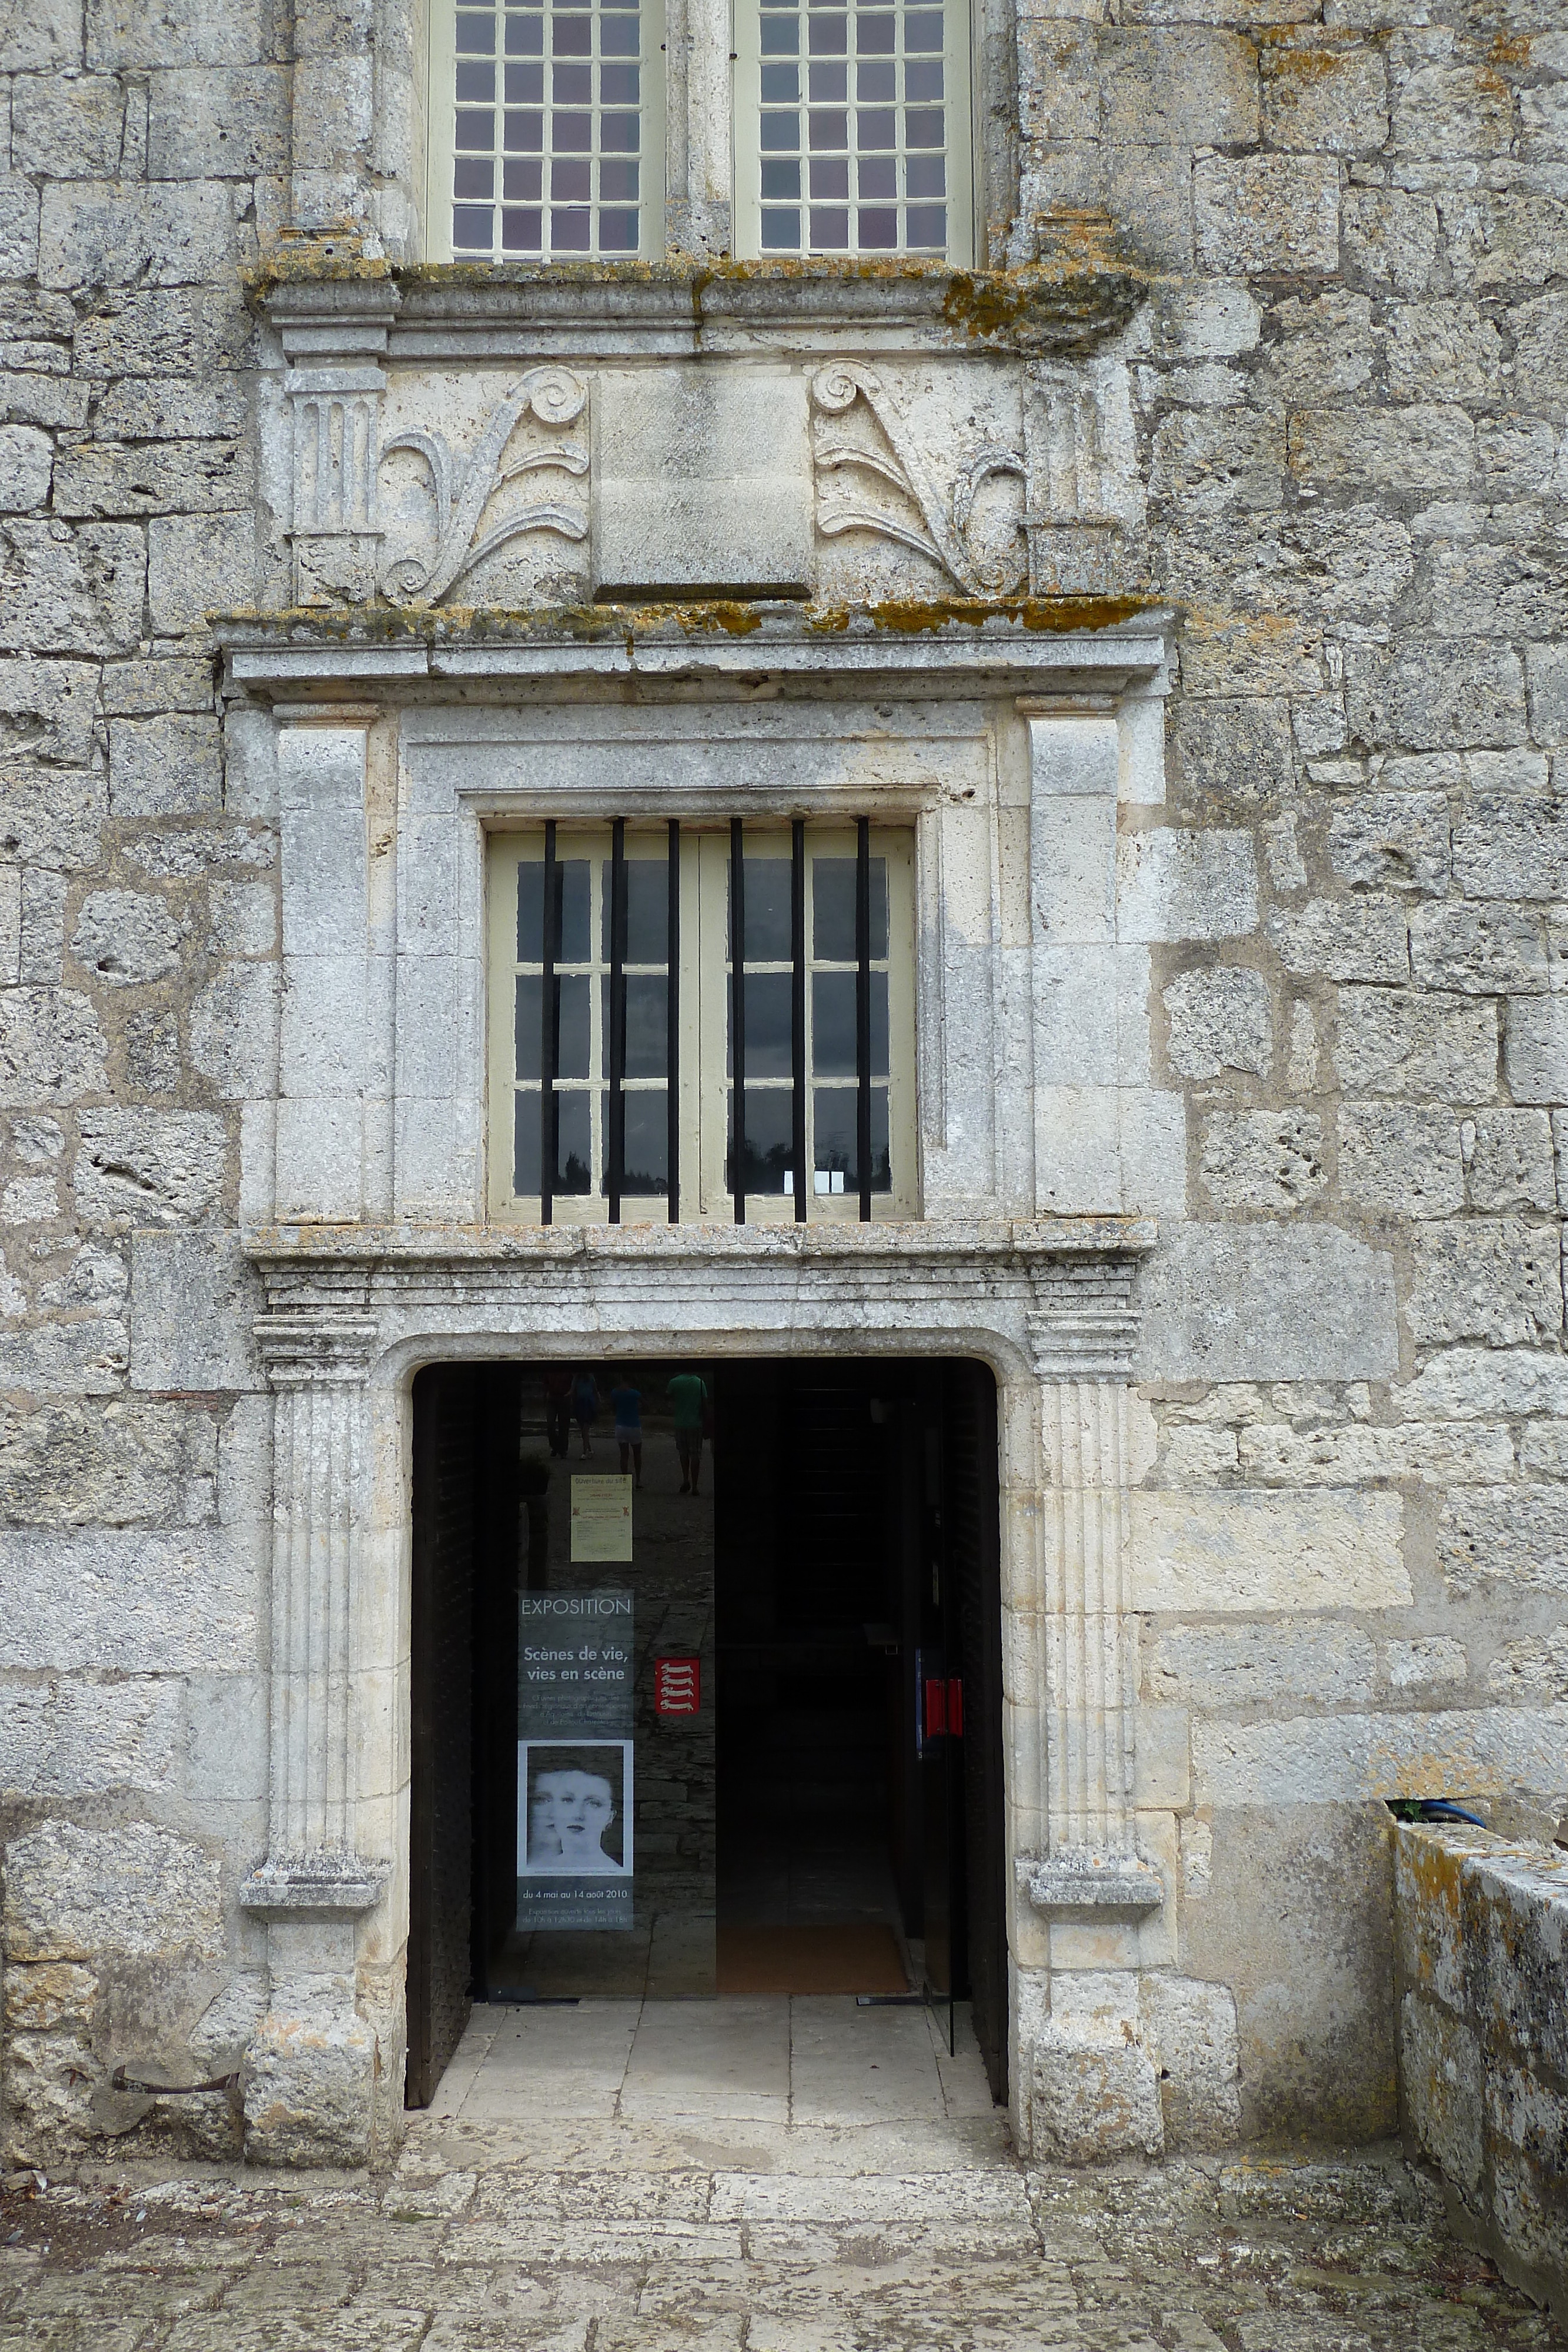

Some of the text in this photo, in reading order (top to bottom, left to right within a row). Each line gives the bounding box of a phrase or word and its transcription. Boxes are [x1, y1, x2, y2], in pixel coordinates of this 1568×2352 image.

[521, 1599, 631, 1615] EXPOSITION
[524, 1645, 628, 1663] Scènes de vie,
[527, 1666, 624, 1680] vies en scène
[523, 1889, 533, 1899] du
[536, 1890, 541, 1899] 4
[543, 1890, 558, 1899] mai
[574, 1890, 584, 1899] 14
[586, 1890, 603, 1899] août
[606, 1890, 627, 1899] 2010
